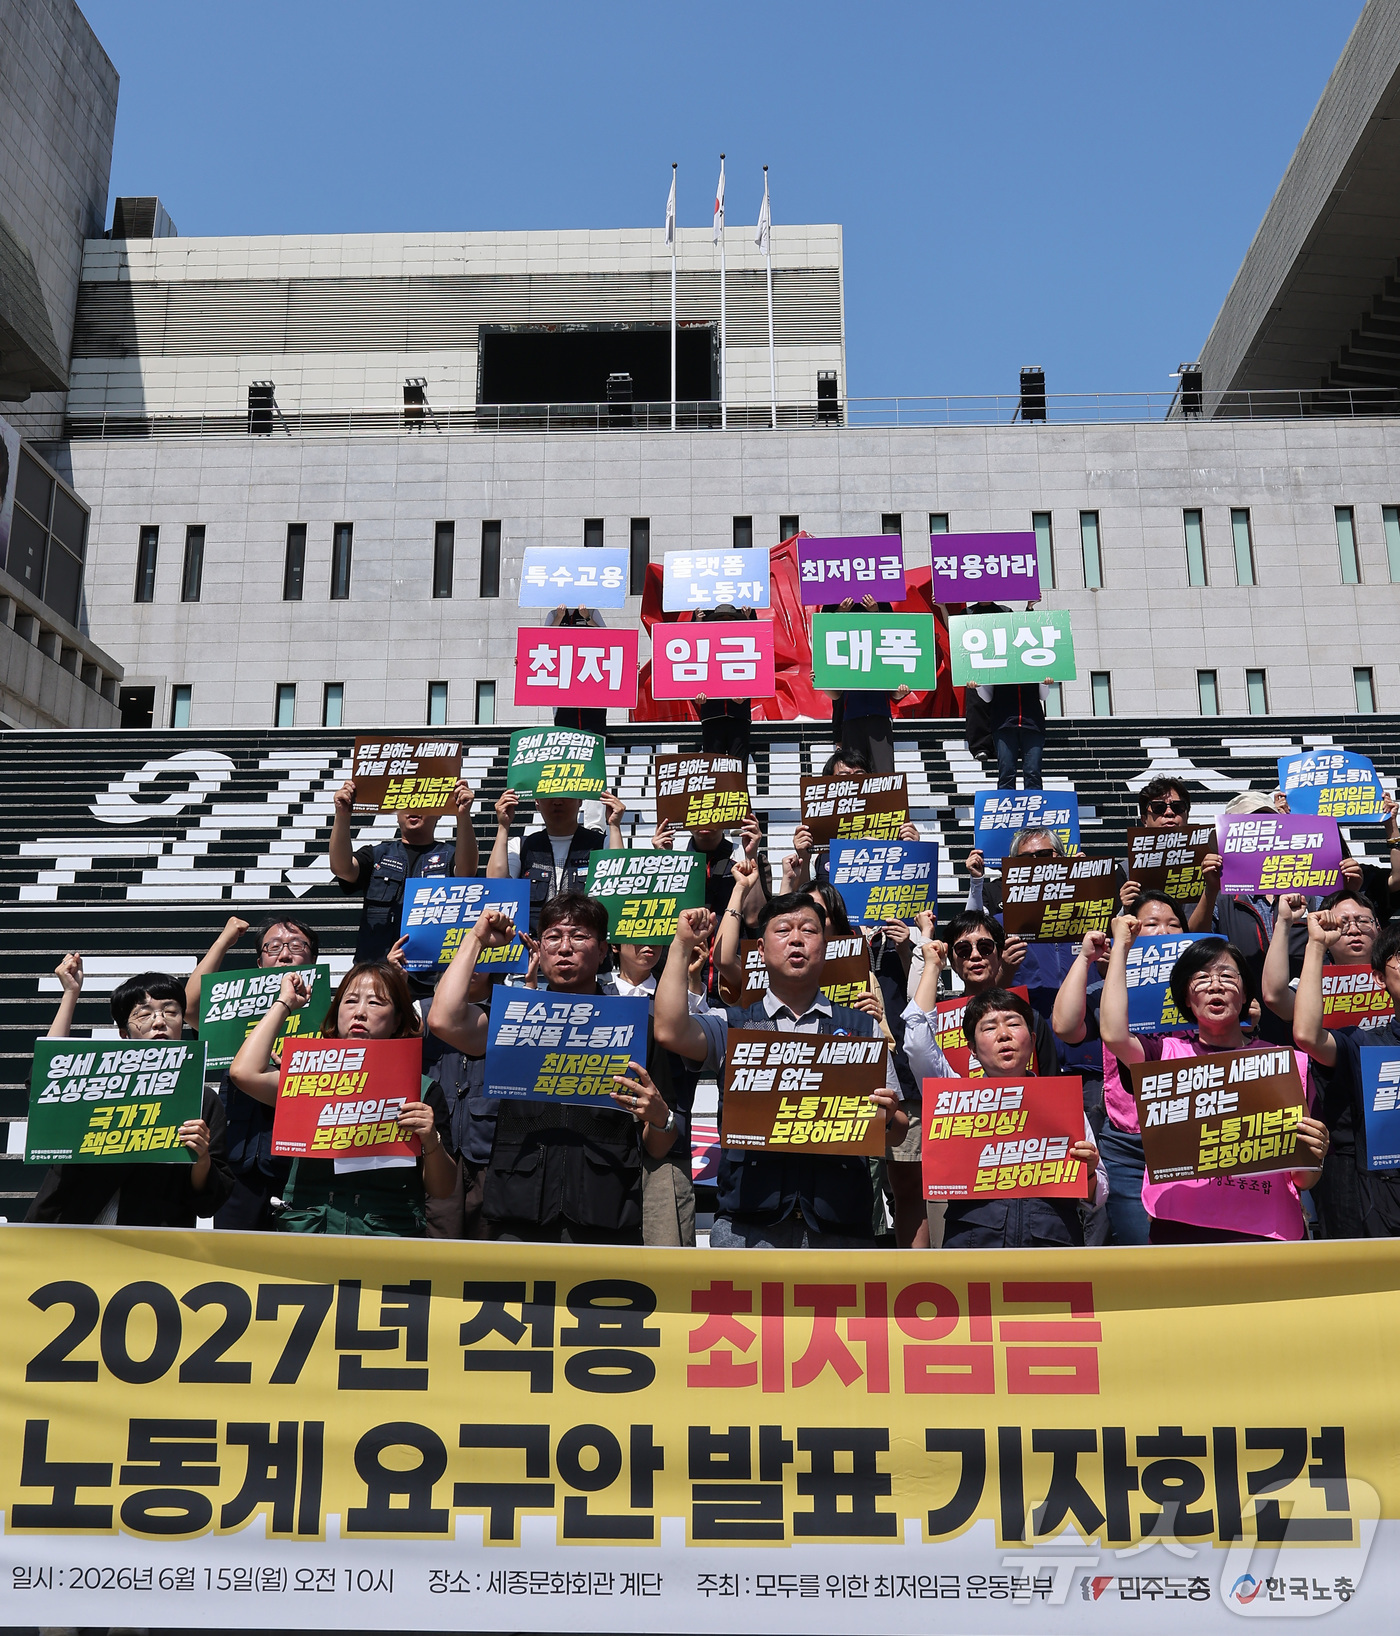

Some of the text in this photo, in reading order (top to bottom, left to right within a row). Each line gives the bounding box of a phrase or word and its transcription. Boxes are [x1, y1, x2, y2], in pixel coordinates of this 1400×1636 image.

[525, 566, 624, 588] 특수고용
[670, 555, 745, 578] 플랫폼
[801, 556, 902, 582] 최저임금
[934, 554, 1036, 580] 적용하라
[687, 581, 763, 602] 노동자
[825, 629, 922, 673] 대폭
[962, 626, 1062, 669] 인상
[526, 644, 624, 690] 최저
[665, 637, 762, 682] 임금
[357, 743, 459, 759] 모든 일하는 사람에게
[517, 734, 544, 751] 영세
[512, 746, 593, 766] 소상공인 지원
[355, 760, 419, 776] 차별 없는
[541, 764, 585, 778] 국가가
[658, 758, 742, 779] 모든 일하는 사람에게
[1285, 769, 1372, 790] 플랫폼 노동자
[386, 777, 458, 793] 노동기본권
[536, 778, 604, 793] 책임져라!!
[659, 775, 716, 796] 차별 없는
[804, 775, 903, 801] 모든 일하는 사람에게
[1319, 786, 1376, 802] 최저임금
[381, 793, 449, 810] 보장하라!!
[688, 791, 748, 810] 노동기본권
[805, 797, 866, 818] 차별 없는
[685, 806, 747, 826] 보장하라!!
[838, 810, 906, 832] 노동기본권
[979, 809, 1070, 830] 플랫폼 노동자
[1132, 836, 1155, 851] 모든
[1155, 833, 1188, 850] 일하는
[1224, 833, 1324, 853] 비정규노동자
[594, 858, 625, 878] 영세
[1132, 849, 1195, 869] 차별 없는
[1262, 853, 1313, 872] 생존권
[834, 862, 930, 884] 플랫폼 노동자
[1006, 859, 1112, 884] 모든 일하는 사람에게
[1258, 870, 1338, 889] 보장하라!!
[588, 875, 689, 897] 소상공인 지원
[867, 884, 929, 903] 최저임금
[1006, 883, 1075, 903] 차별 없는
[406, 905, 461, 926] 플랫폼
[622, 898, 676, 918] 국가가
[1043, 898, 1114, 920] 노동기본권
[210, 968, 321, 1003] 영세 자영자·
[495, 1024, 634, 1048] 플랫폼 노동자
[288, 1048, 366, 1074] 최저임금
[540, 1053, 631, 1075] 최저임금
[731, 1041, 883, 1065] 모든 일하는 사람에게
[47, 1053, 96, 1079] 영세
[1140, 1050, 1290, 1100] 모든 일하는 사람에게
[37, 1071, 180, 1104] 소상공인 지원
[282, 1072, 369, 1098] 대폭인상!
[729, 1068, 823, 1091] 차별 없는
[317, 1097, 407, 1126] 실질임금
[776, 1096, 878, 1119] 노동기본권
[934, 1086, 1024, 1115] 최저임금
[1145, 1090, 1239, 1127] 차별 없는
[89, 1102, 162, 1130] 국가가
[928, 1111, 1028, 1140] 대폭인상!
[1199, 1105, 1303, 1146] 노동기본권
[769, 1120, 869, 1144] 보장하라!!
[978, 1137, 1070, 1167] 실질임금
[1198, 1133, 1297, 1172] 보장하라!!
[973, 1160, 1081, 1192] 보장하라!!
[25, 1279, 1102, 1395] 2027년 적용 최저임금
[11, 1418, 1353, 1542] 노동계 요구안 발표 기자회견
[12, 1567, 52, 1590] 일시
[69, 1567, 153, 1591] 2026년
[158, 1567, 195, 1591] 6월
[203, 1567, 288, 1592] 15일(월)
[293, 1568, 335, 1592] 오전
[344, 1568, 394, 1593] 10시
[428, 1569, 470, 1593] 장소
[486, 1570, 615, 1596] 세종문화회관
[620, 1572, 662, 1597] 계단
[697, 1573, 739, 1598] 주최
[756, 1574, 820, 1599] 모두를
[825, 1573, 869, 1599] 위한
[874, 1574, 960, 1599] 최저임금
[966, 1574, 1053, 1599] 운동본부
[1118, 1576, 1211, 1601] 민주노총
[1265, 1576, 1355, 1602] 한국노총
